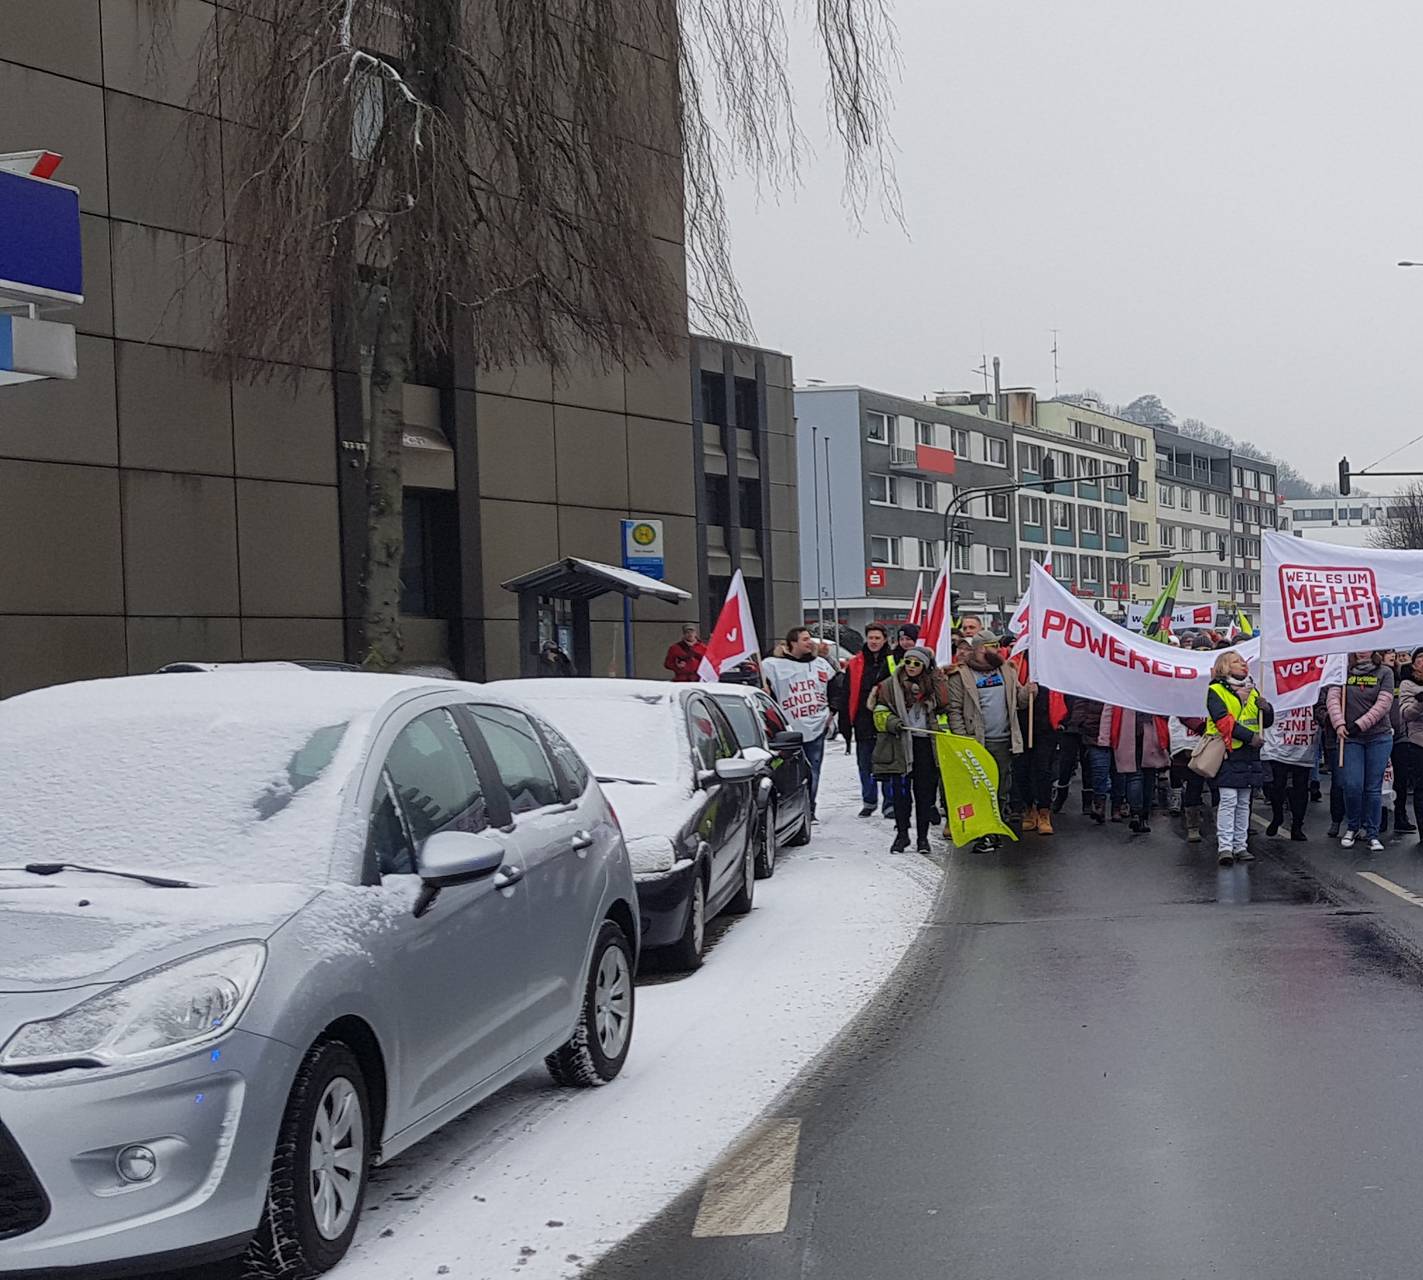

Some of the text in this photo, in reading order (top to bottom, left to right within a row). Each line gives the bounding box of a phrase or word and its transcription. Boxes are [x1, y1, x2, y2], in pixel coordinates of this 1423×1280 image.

[1286, 571, 1368, 585] WEIL ES UM
[1288, 584, 1370, 609] MEHR
[1291, 602, 1376, 634] GEHT!
[789, 679, 816, 693] WIR
[782, 693, 812, 710] SIND
[1291, 706, 1312, 718] WIR
[1284, 733, 1315, 746] WERT
